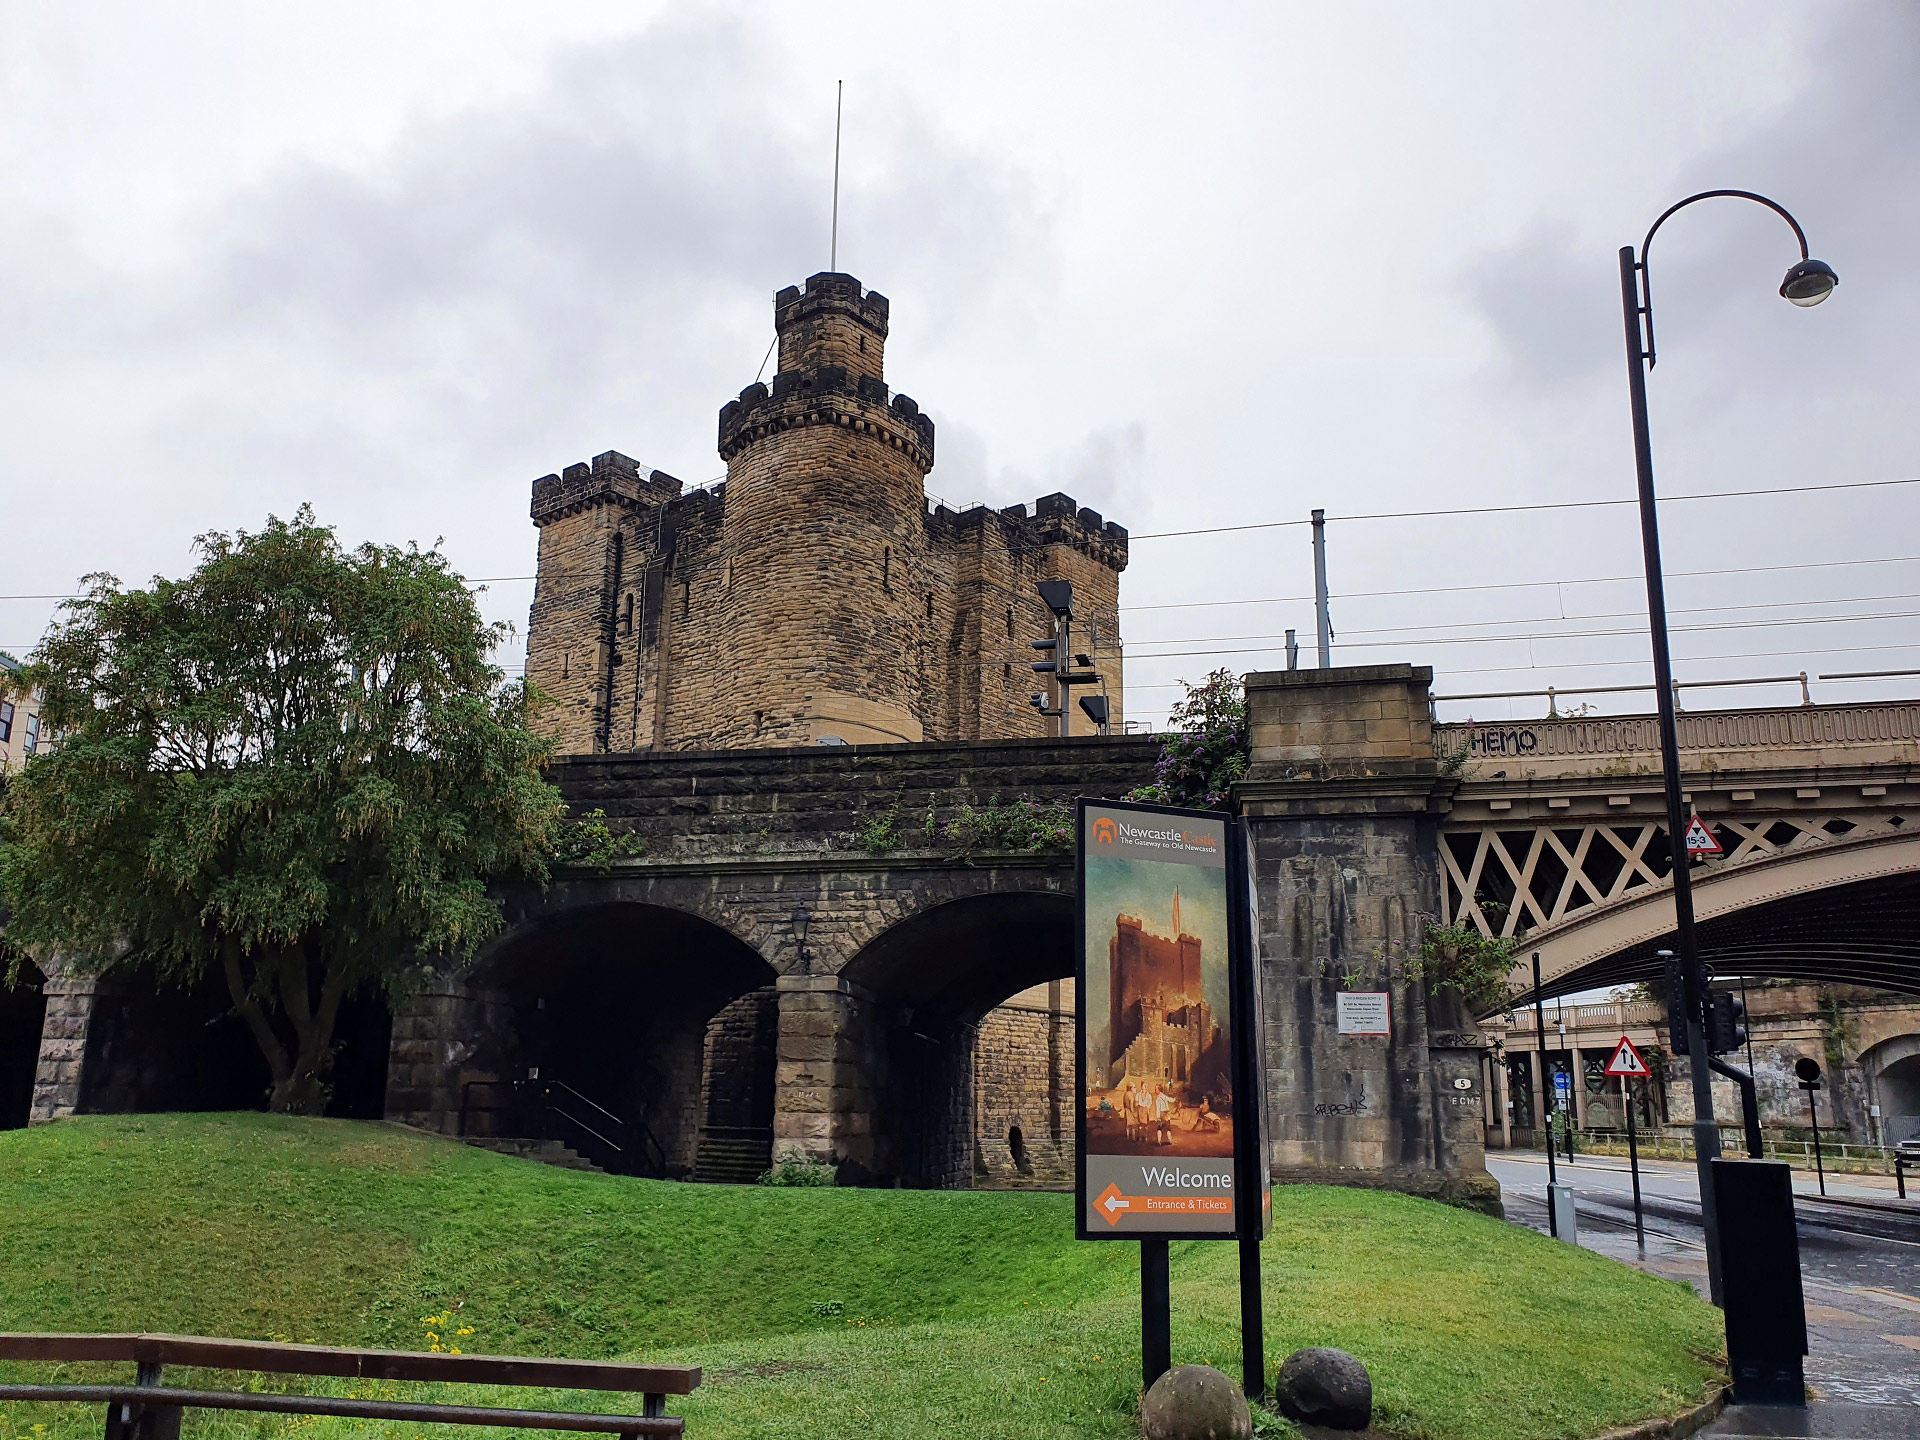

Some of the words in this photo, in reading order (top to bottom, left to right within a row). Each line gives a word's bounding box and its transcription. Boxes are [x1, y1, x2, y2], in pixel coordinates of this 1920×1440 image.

[1471, 729, 1537, 754] HEMO
[1119, 822, 1182, 842] Newcastle
[1182, 830, 1217, 847] Castle
[1120, 836, 1133, 845] The
[1134, 838, 1161, 849] Gateway
[1171, 842, 1184, 850] Old
[1460, 1080, 1466, 1088] 5
[1141, 1166, 1232, 1188] Welcome
[1147, 1199, 1186, 1209] Entrance
[1188, 1200, 1195, 1209] &
[1196, 1199, 1227, 1210] Tickets
